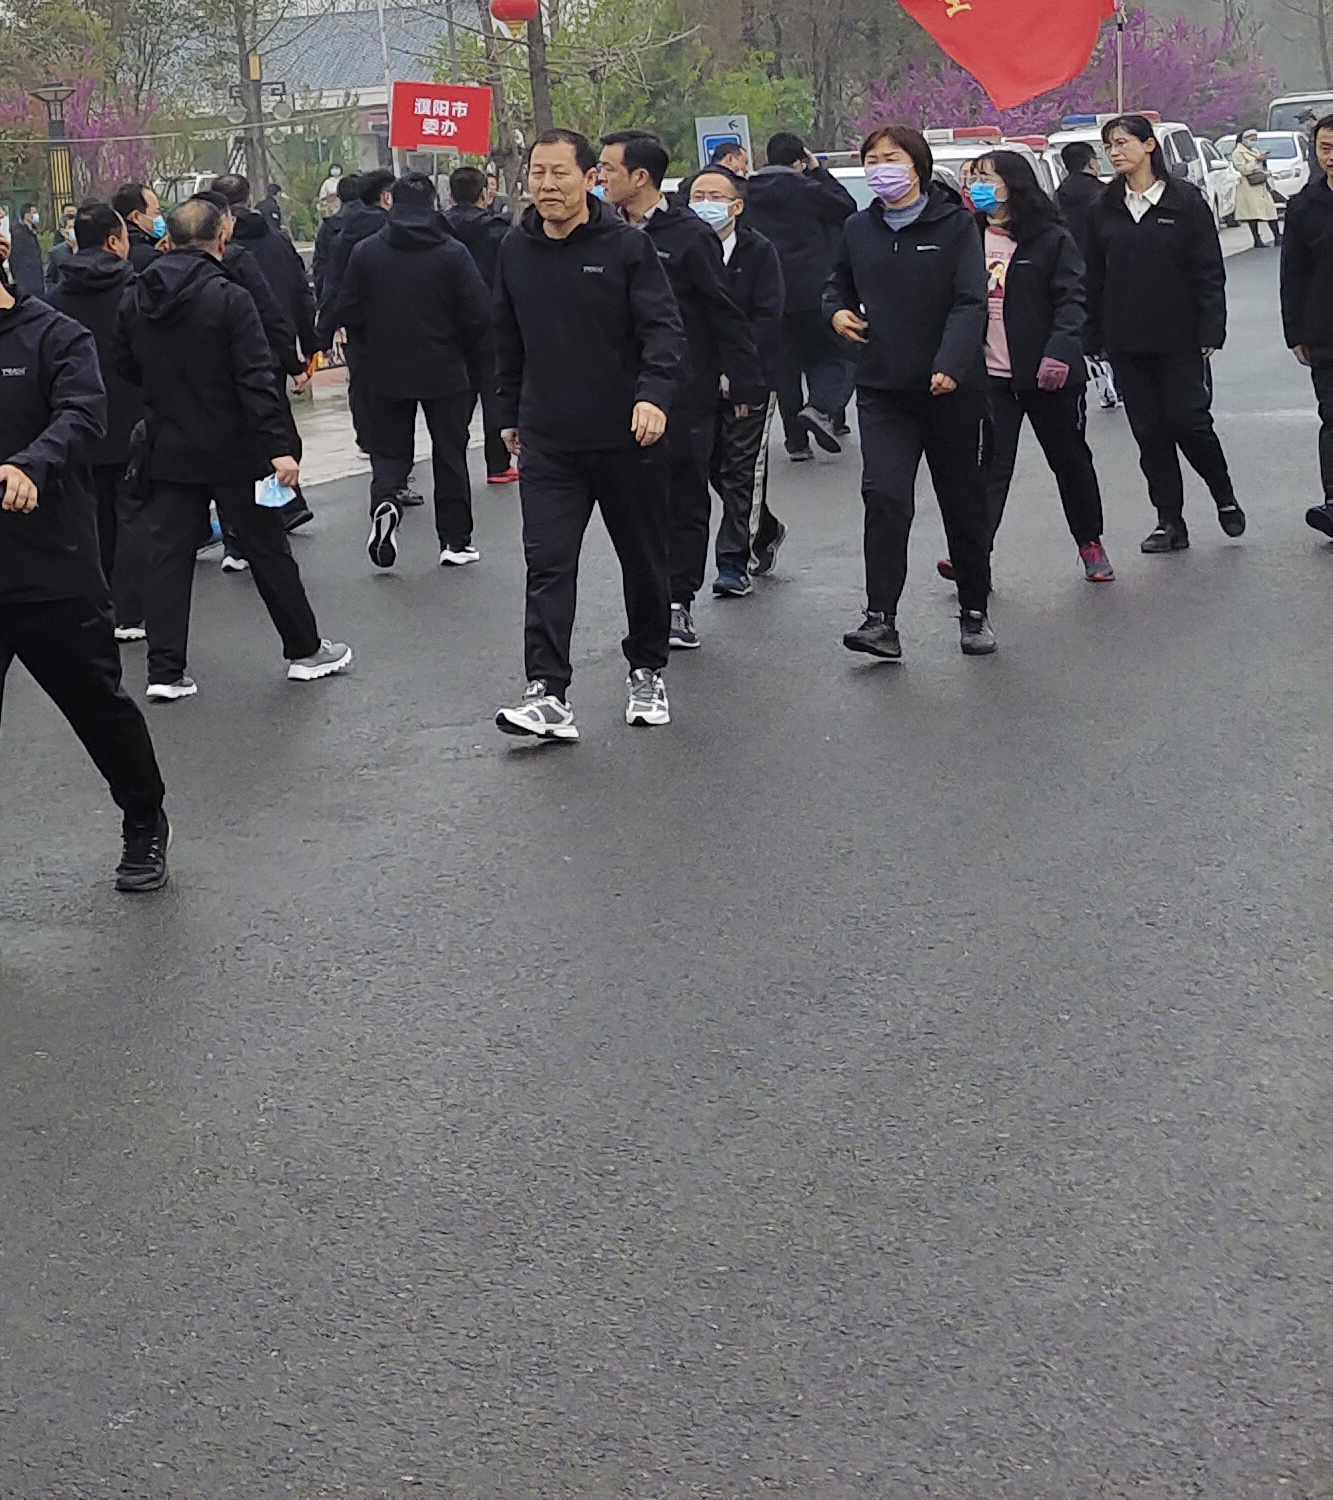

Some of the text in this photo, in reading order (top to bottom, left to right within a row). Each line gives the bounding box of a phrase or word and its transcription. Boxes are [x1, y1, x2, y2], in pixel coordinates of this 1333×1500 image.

[413, 97, 469, 118] 濮阳市
[421, 118, 458, 137] 委办
